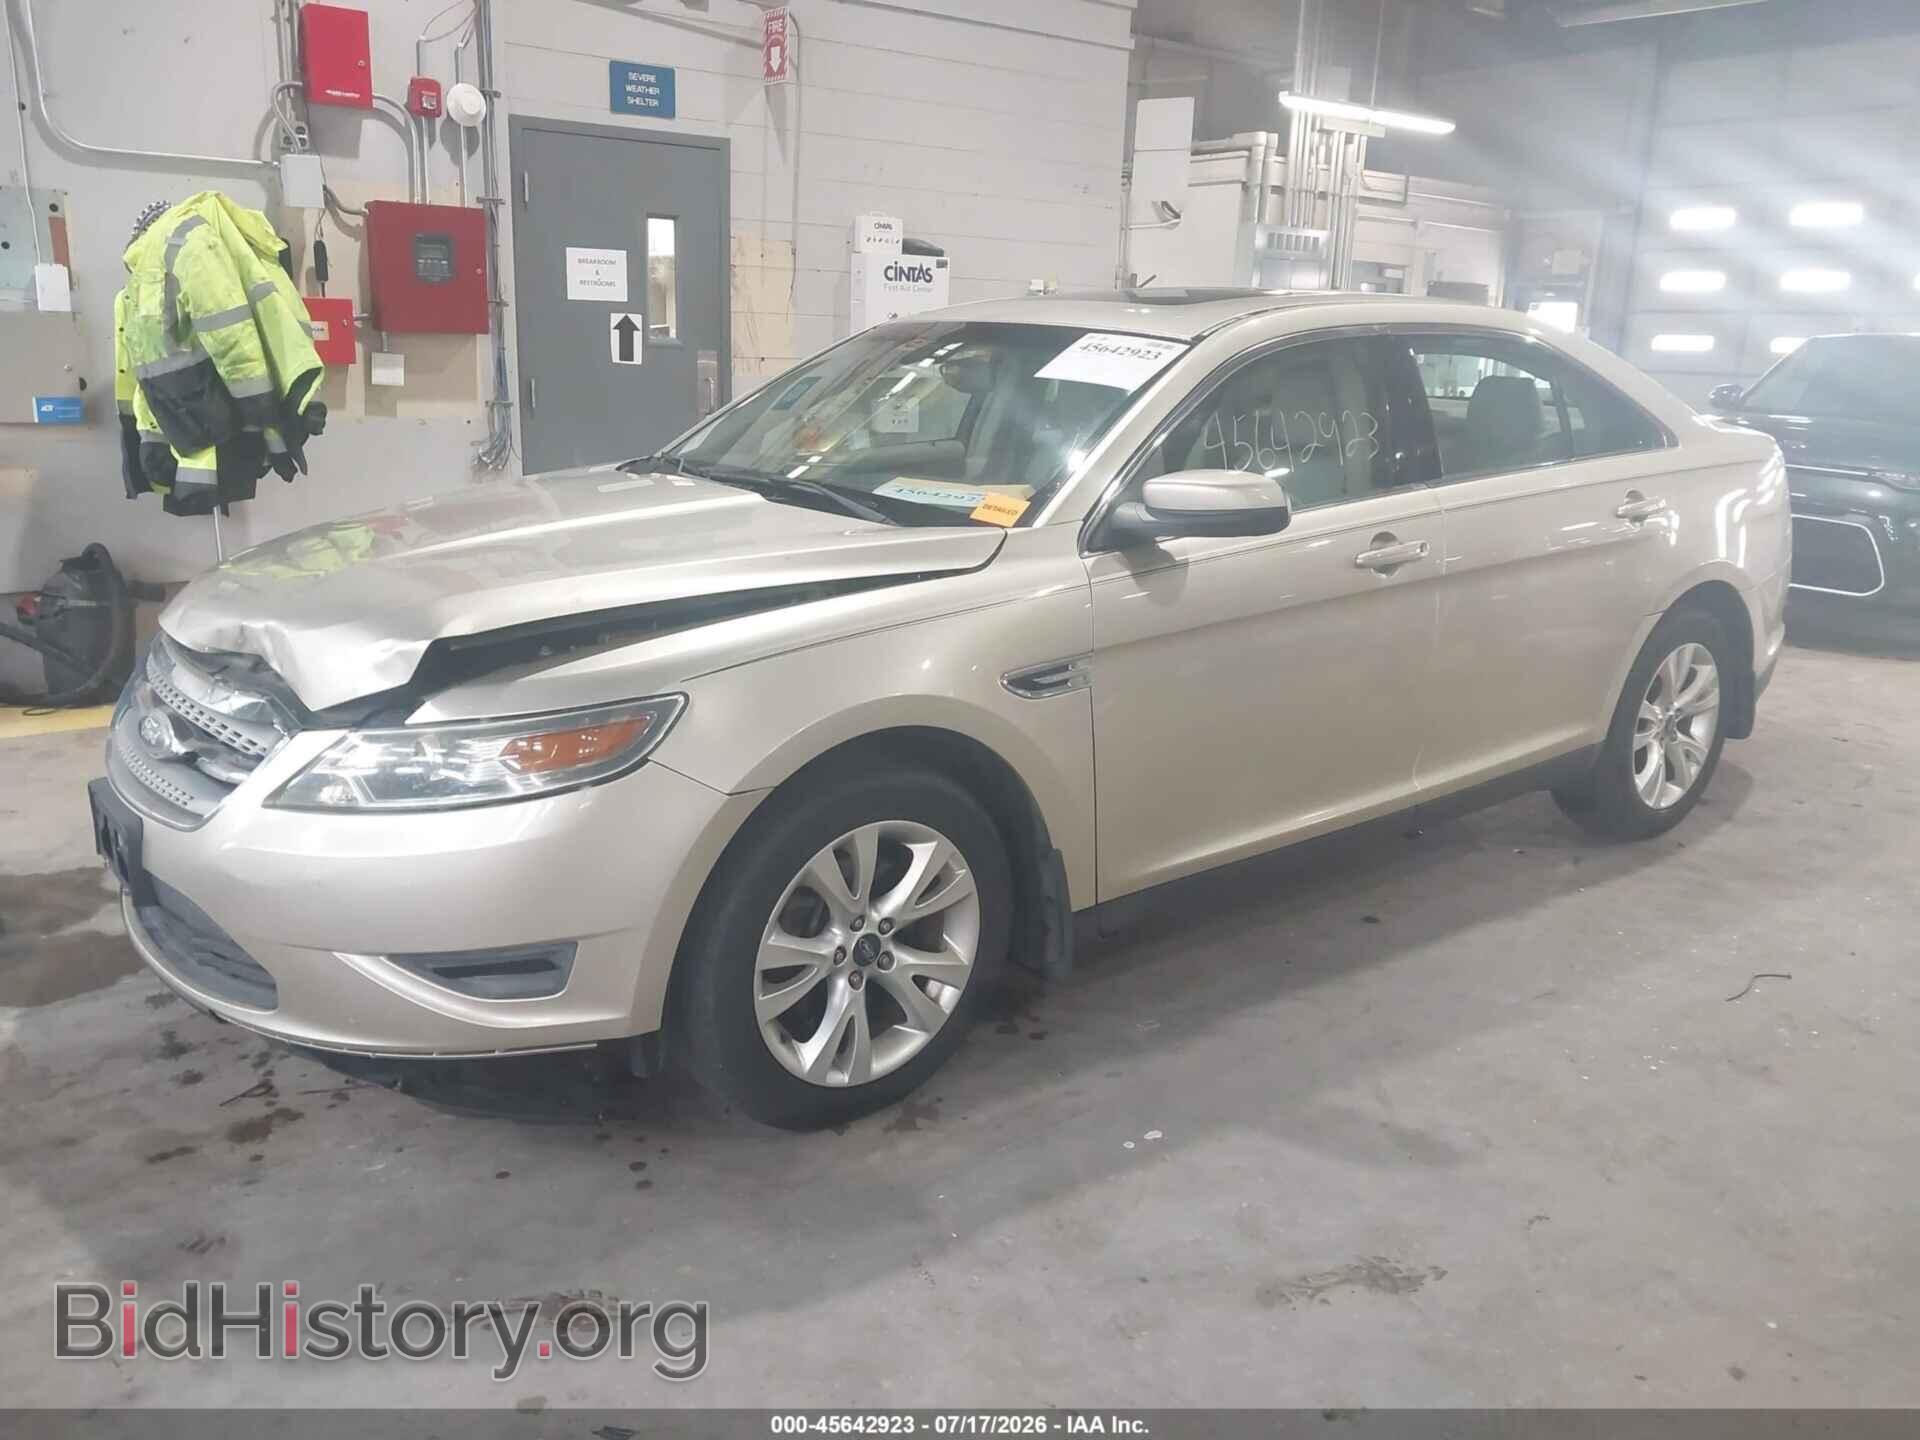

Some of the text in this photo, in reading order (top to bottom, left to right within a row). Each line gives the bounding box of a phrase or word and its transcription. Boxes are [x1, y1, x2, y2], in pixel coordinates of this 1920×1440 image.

[768, 19, 784, 33] FIRE
[628, 72, 657, 83] SEVERE
[625, 84, 660, 95] WEATHER
[626, 96, 659, 107] SHELTER
[577, 257, 617, 266] BREAKROOM
[579, 279, 617, 288] RESTROOMS
[1080, 343, 1162, 360] 45642923
[1203, 410, 1379, 473] 45642923
[895, 488, 985, 502] 4564292
